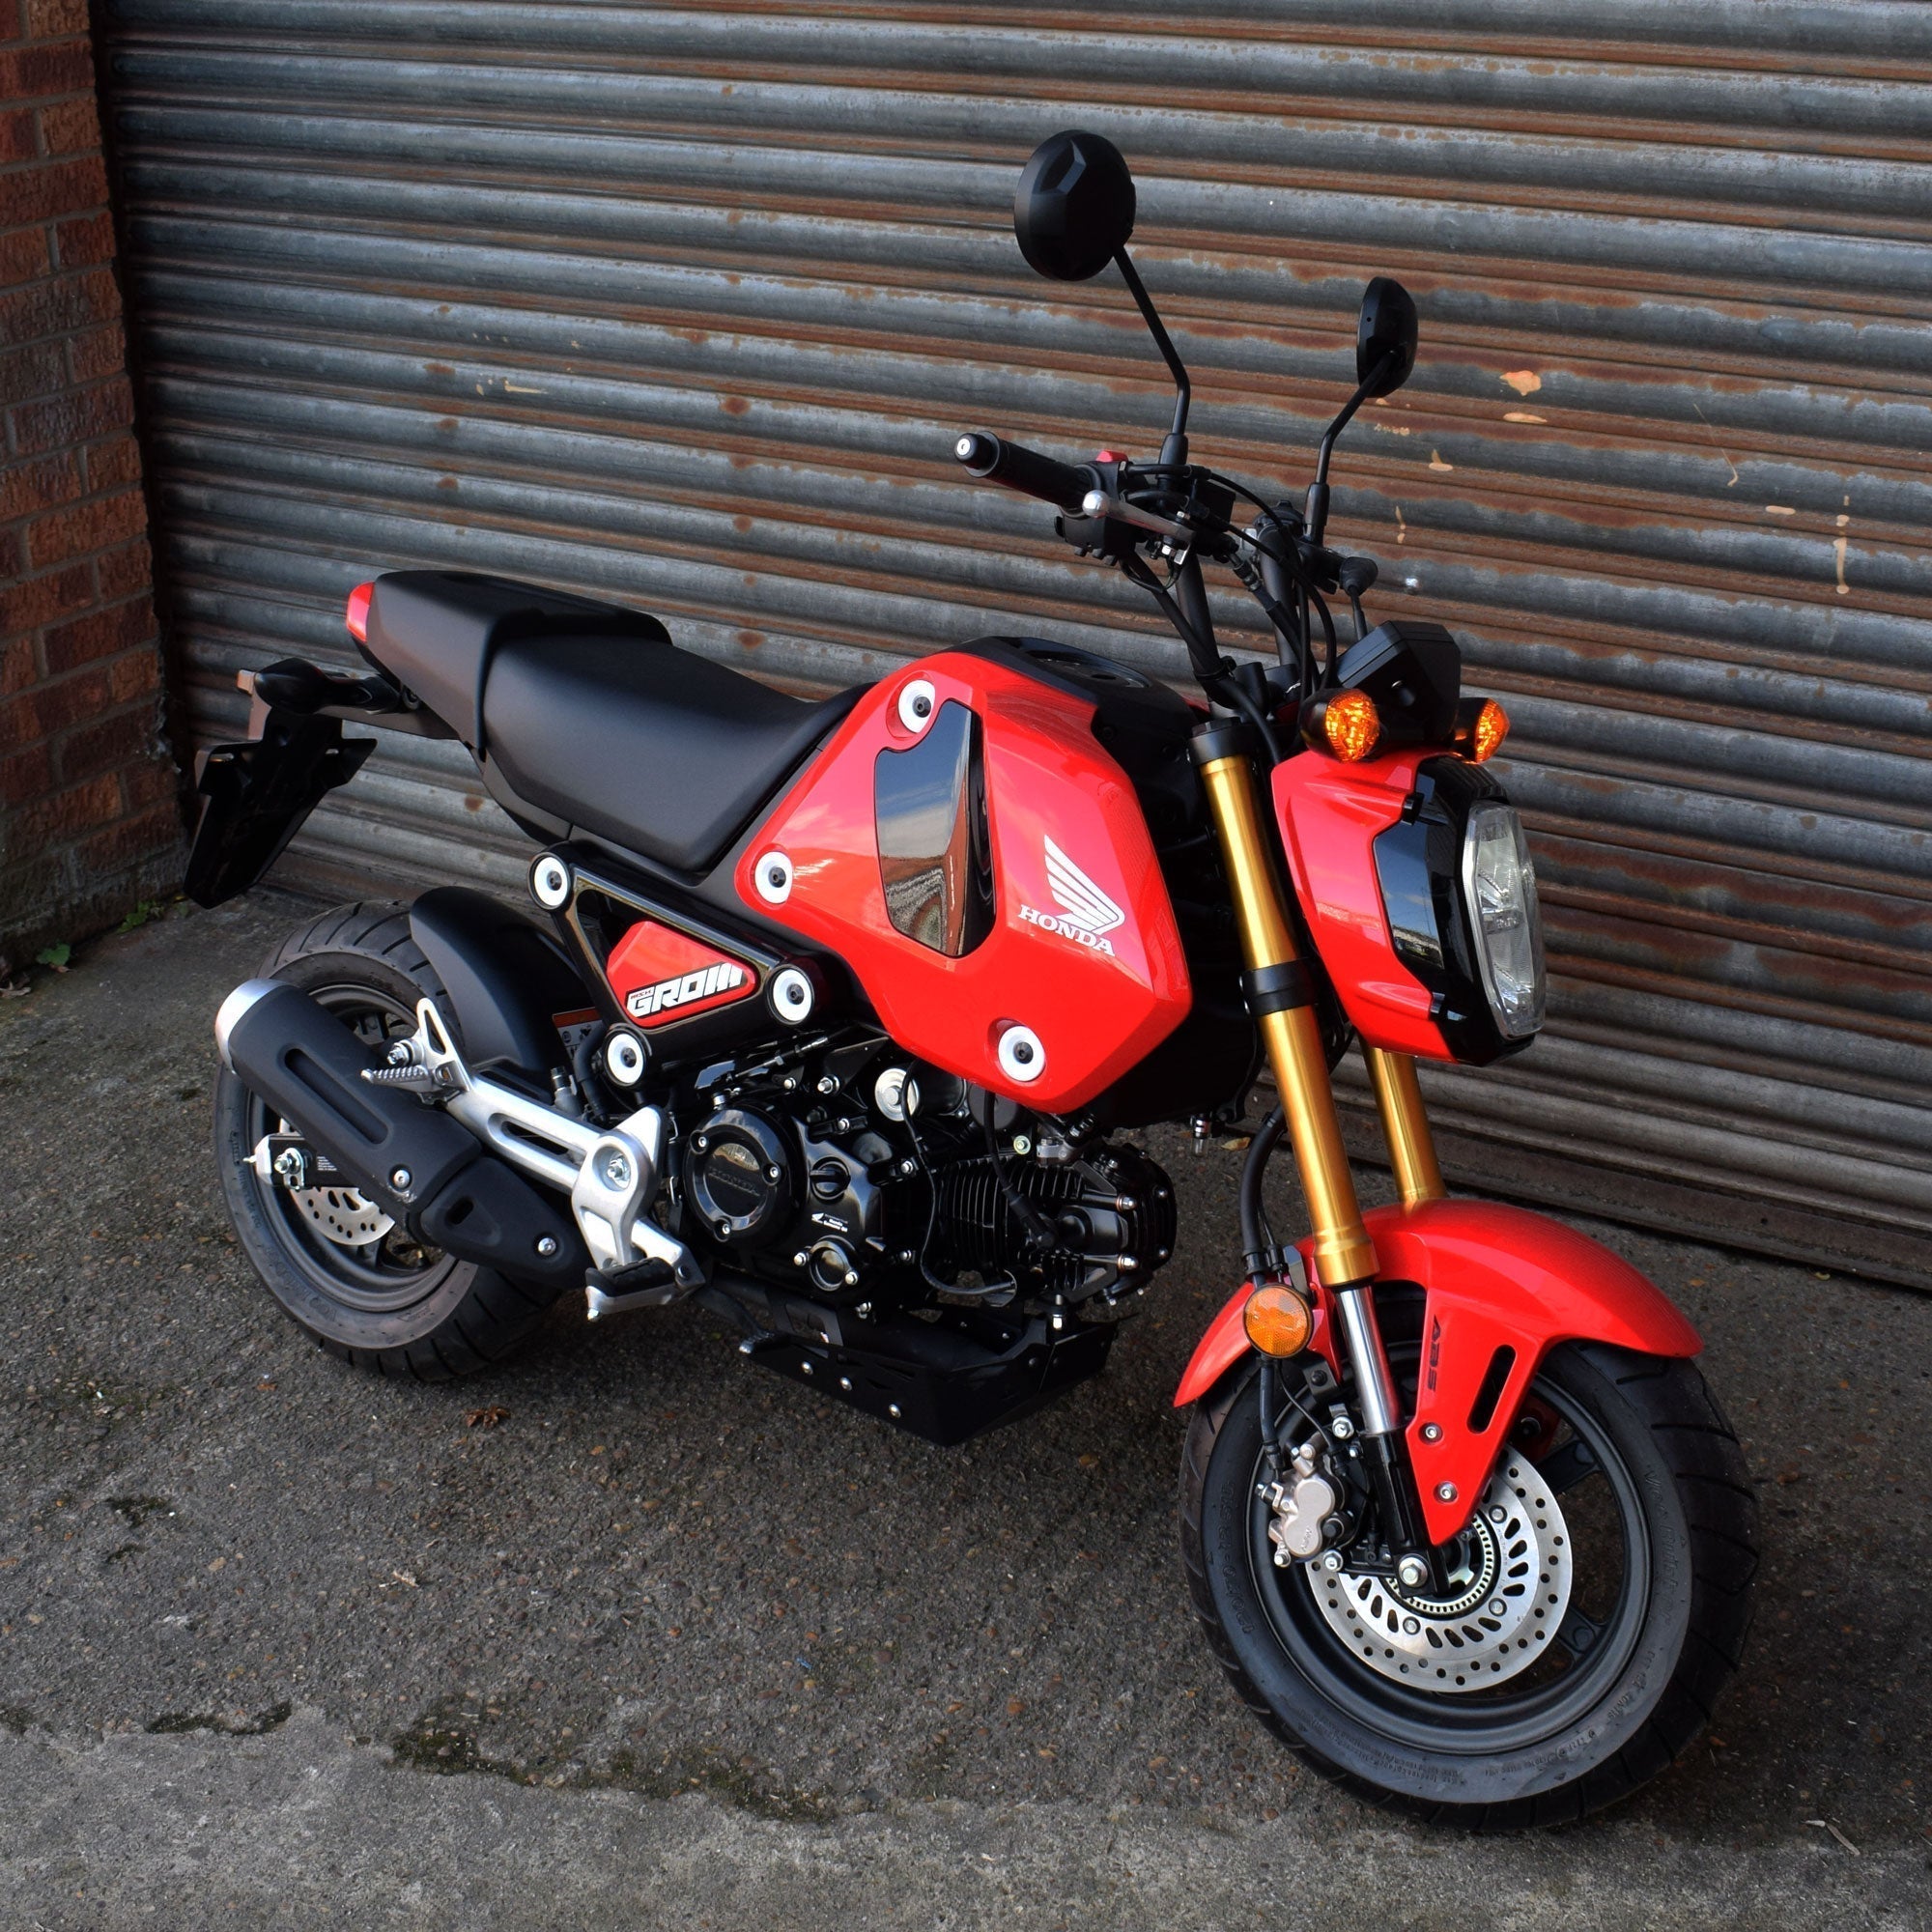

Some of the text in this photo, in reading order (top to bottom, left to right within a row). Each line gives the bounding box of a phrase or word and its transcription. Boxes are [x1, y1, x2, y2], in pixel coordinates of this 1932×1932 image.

[1017, 904, 1116, 957] HONDA
[626, 962, 744, 1017] GROM
[1427, 1314, 1441, 1392] ABS
